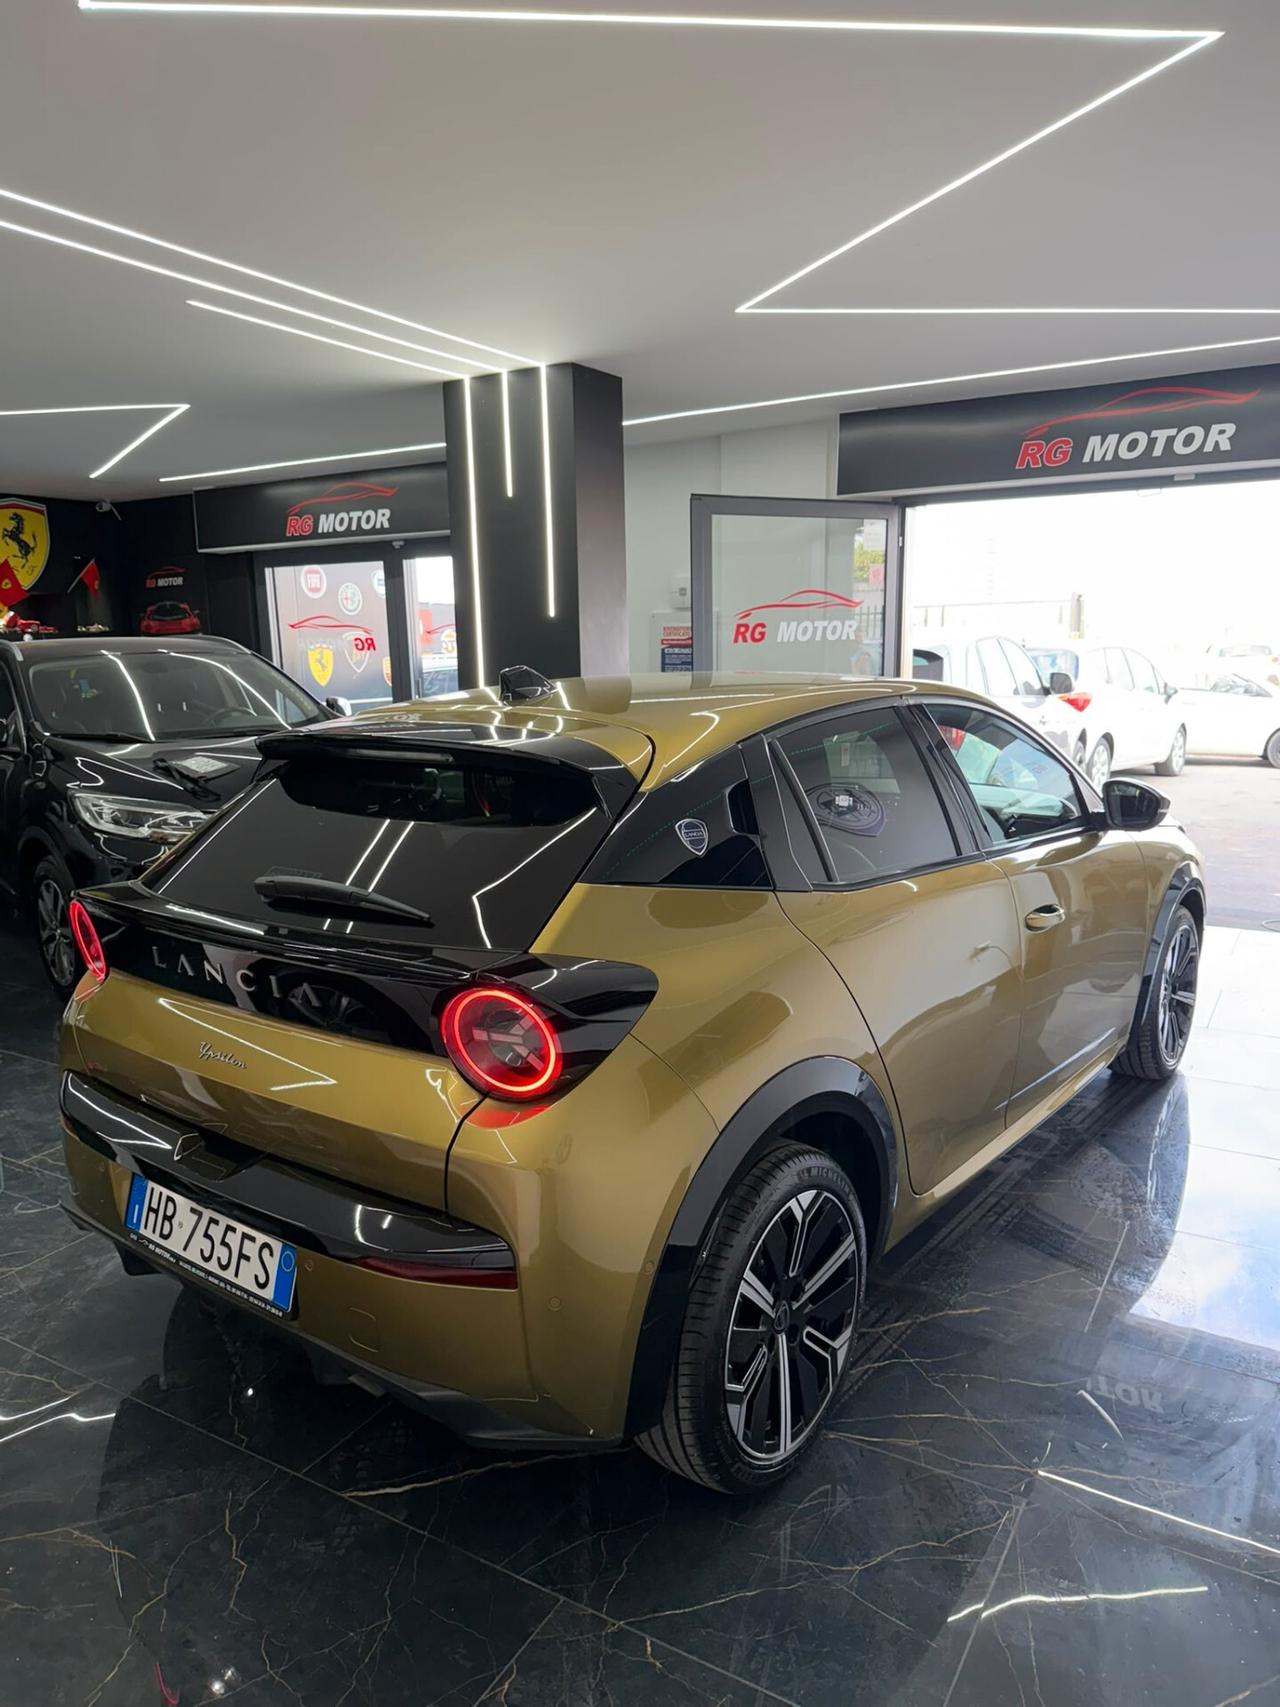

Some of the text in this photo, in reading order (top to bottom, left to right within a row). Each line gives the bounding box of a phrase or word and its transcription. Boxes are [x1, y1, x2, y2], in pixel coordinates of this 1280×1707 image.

[1015, 422, 1237, 469] RG MOTOR
[286, 508, 391, 537] RG MOTOR
[157, 576, 184, 587] MOTOR
[733, 620, 858, 644] RG MOTOR
[152, 946, 321, 1008] LANCIA
[199, 1041, 248, 1070] Ypsilon
[144, 1186, 274, 1290] HB 755FS
